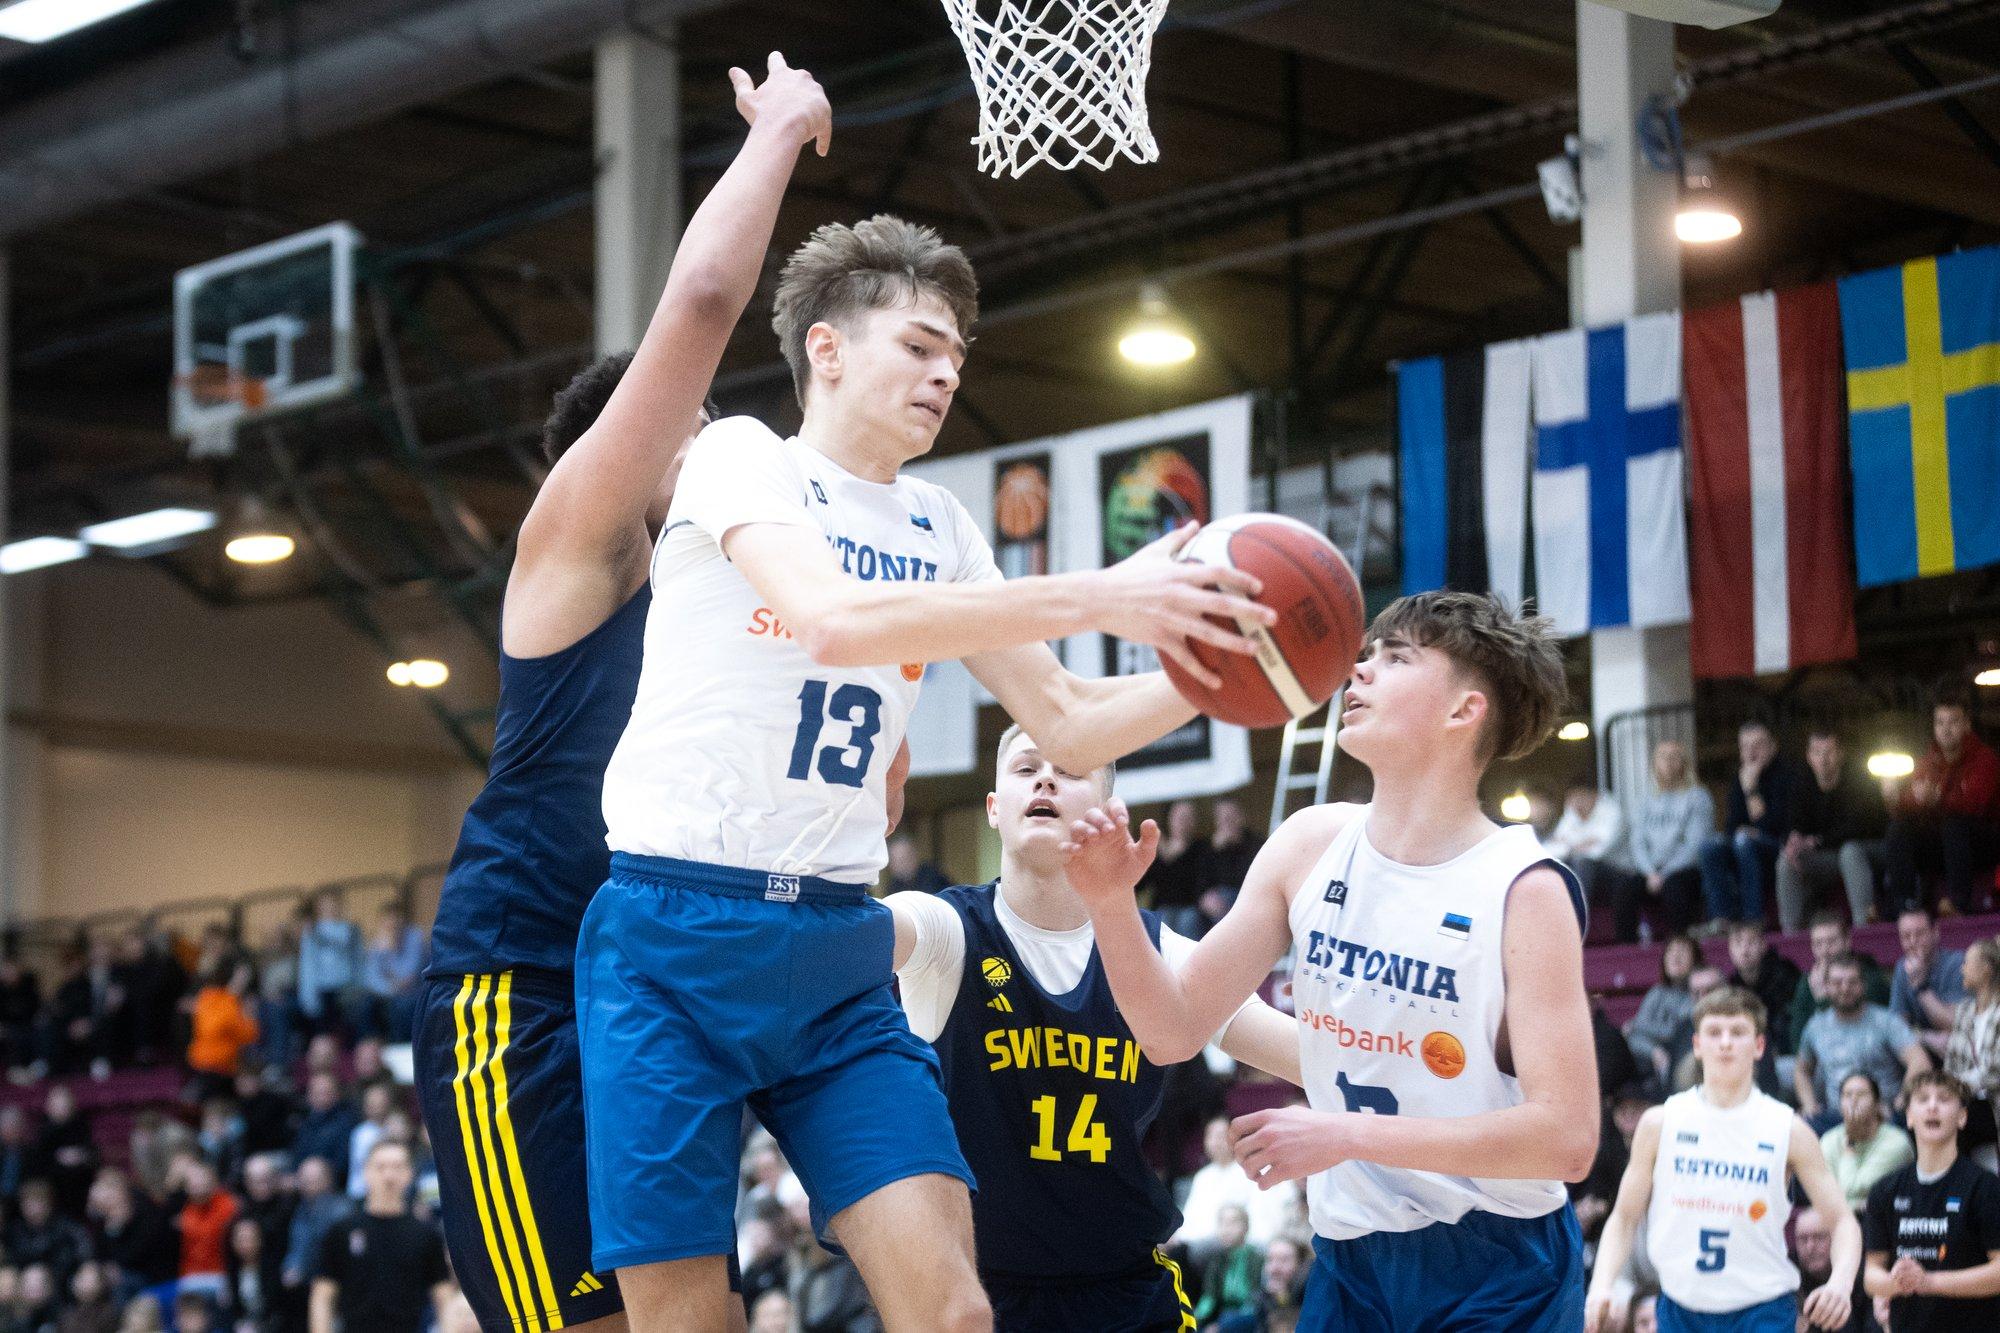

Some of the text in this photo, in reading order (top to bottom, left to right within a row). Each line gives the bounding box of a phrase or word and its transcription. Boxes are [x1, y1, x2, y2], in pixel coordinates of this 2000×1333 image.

[827, 536, 937, 581] TONIA
[787, 679, 883, 788] 13
[769, 876, 798, 894] EST
[1306, 930, 1460, 1003] ESTONIA
[984, 1026, 1142, 1084] SWEDEN
[1030, 1093, 1112, 1163] 14
[1674, 1155, 1769, 1185] ESTONIA
[1696, 1227, 1730, 1273] 5
